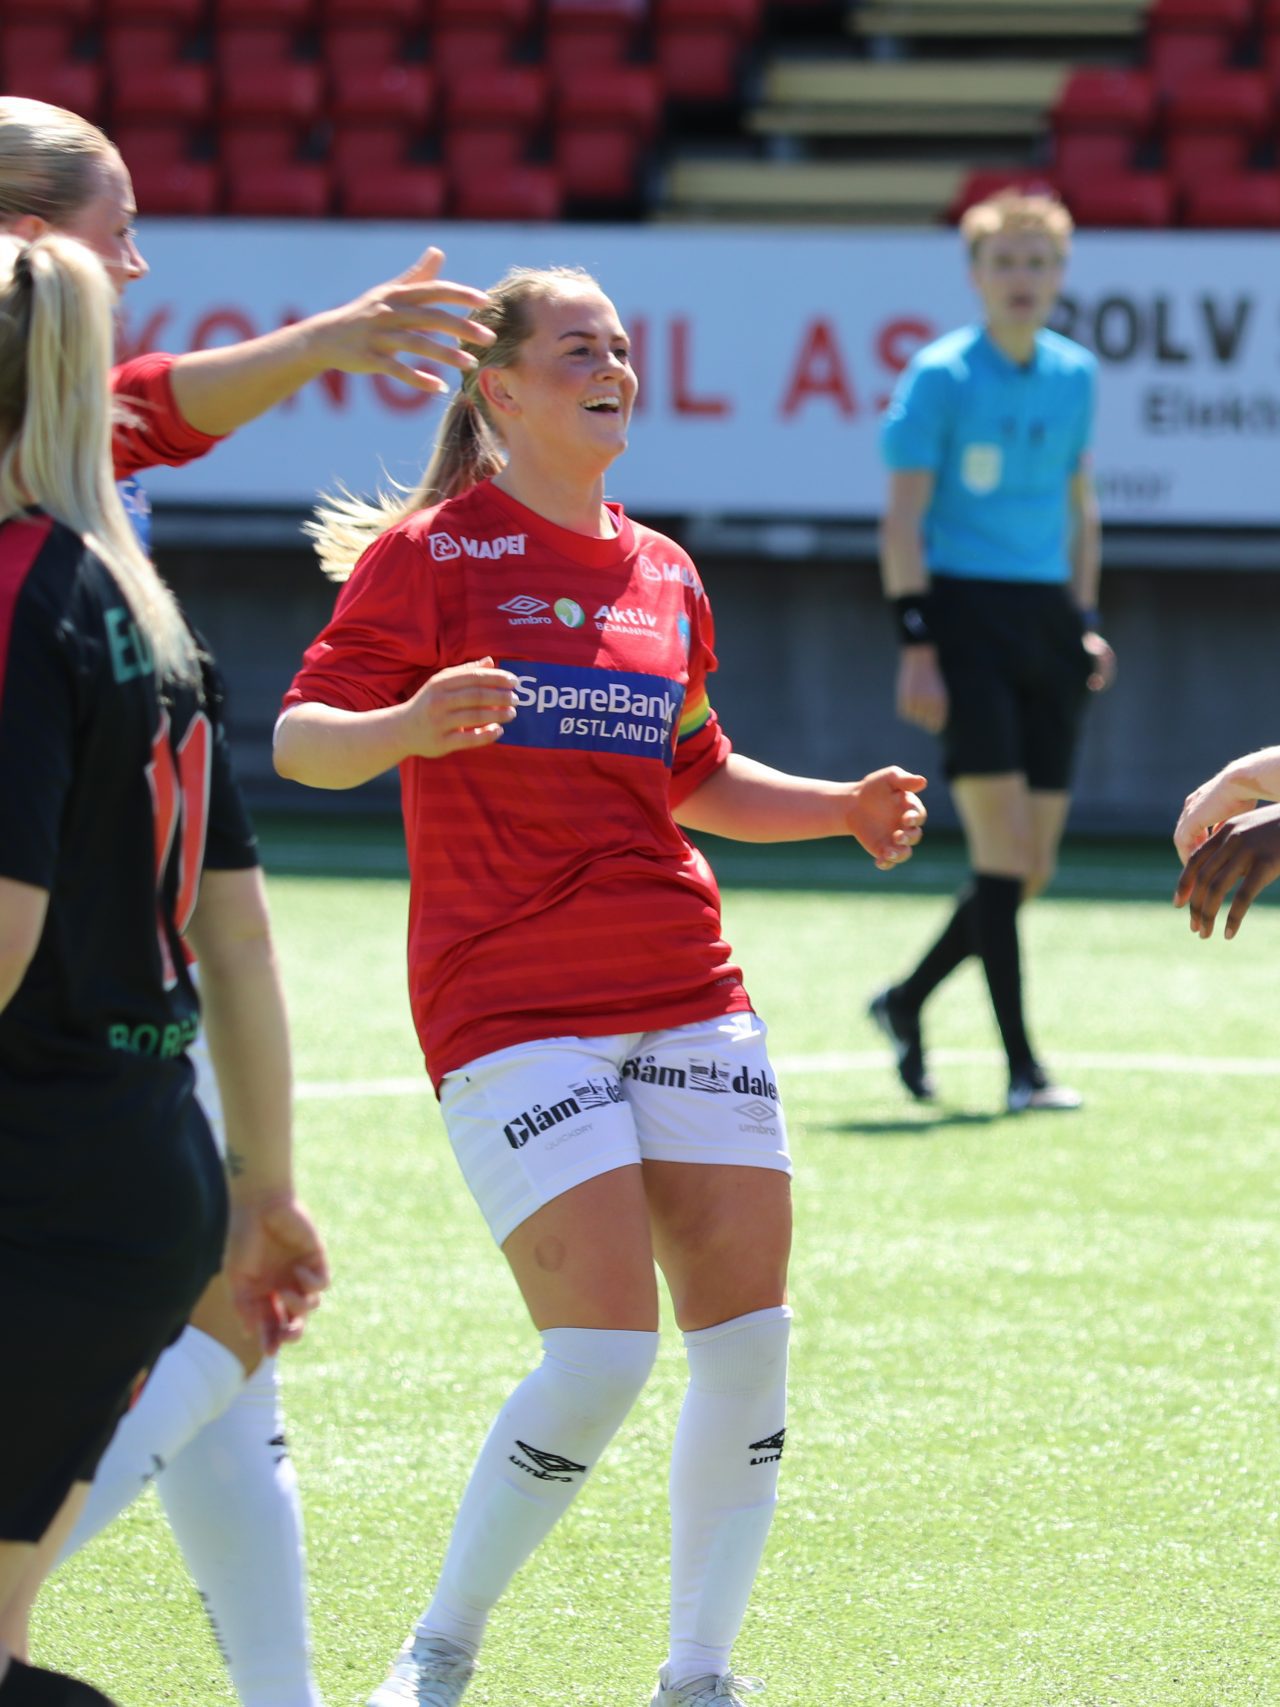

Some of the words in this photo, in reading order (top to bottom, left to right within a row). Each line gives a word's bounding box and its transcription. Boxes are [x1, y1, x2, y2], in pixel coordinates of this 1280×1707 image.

[460, 534, 527, 559] MAPEI
[509, 617, 552, 625] umbro
[593, 605, 657, 627] Aktiv
[514, 676, 676, 723] SpareBank
[732, 1066, 779, 1101] dale
[503, 1097, 583, 1150] Glåm
[738, 1123, 777, 1137] umbro
